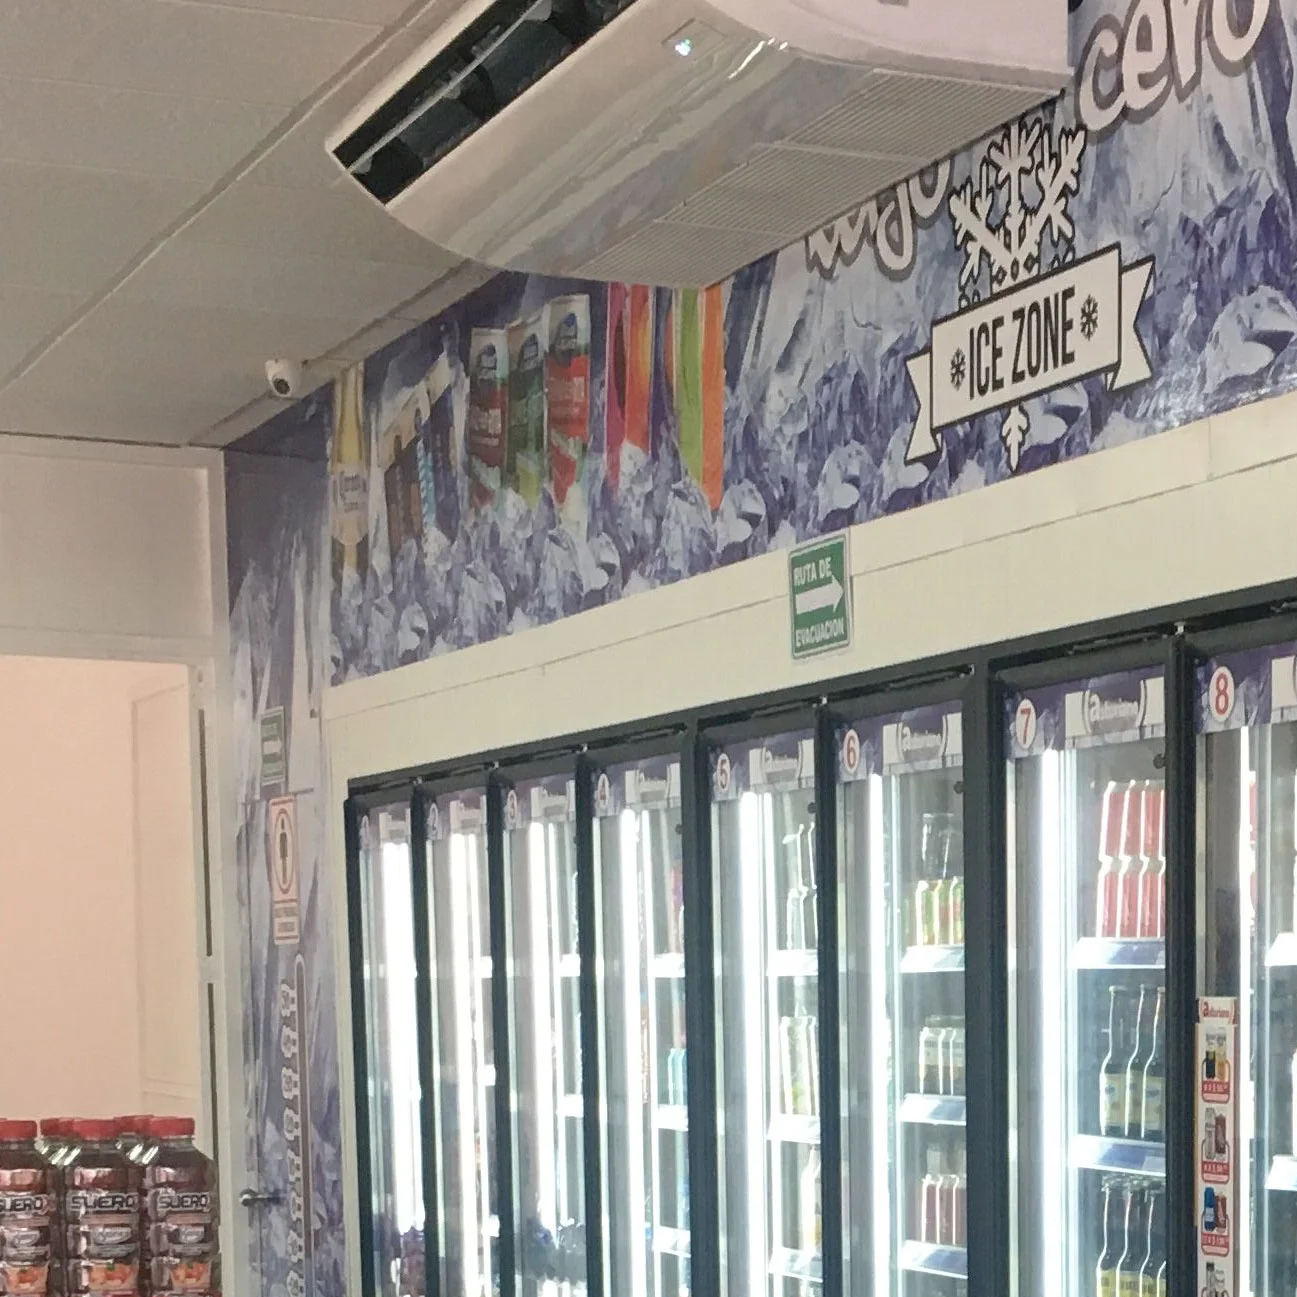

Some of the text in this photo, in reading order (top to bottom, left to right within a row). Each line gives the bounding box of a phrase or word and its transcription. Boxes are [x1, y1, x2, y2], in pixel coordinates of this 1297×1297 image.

[968, 285, 1075, 400] ICE ZONE
[793, 557, 832, 586] RUTA DE
[1214, 672, 1229, 716] 8
[1020, 706, 1032, 745] 7
[846, 738, 857, 770] 6
